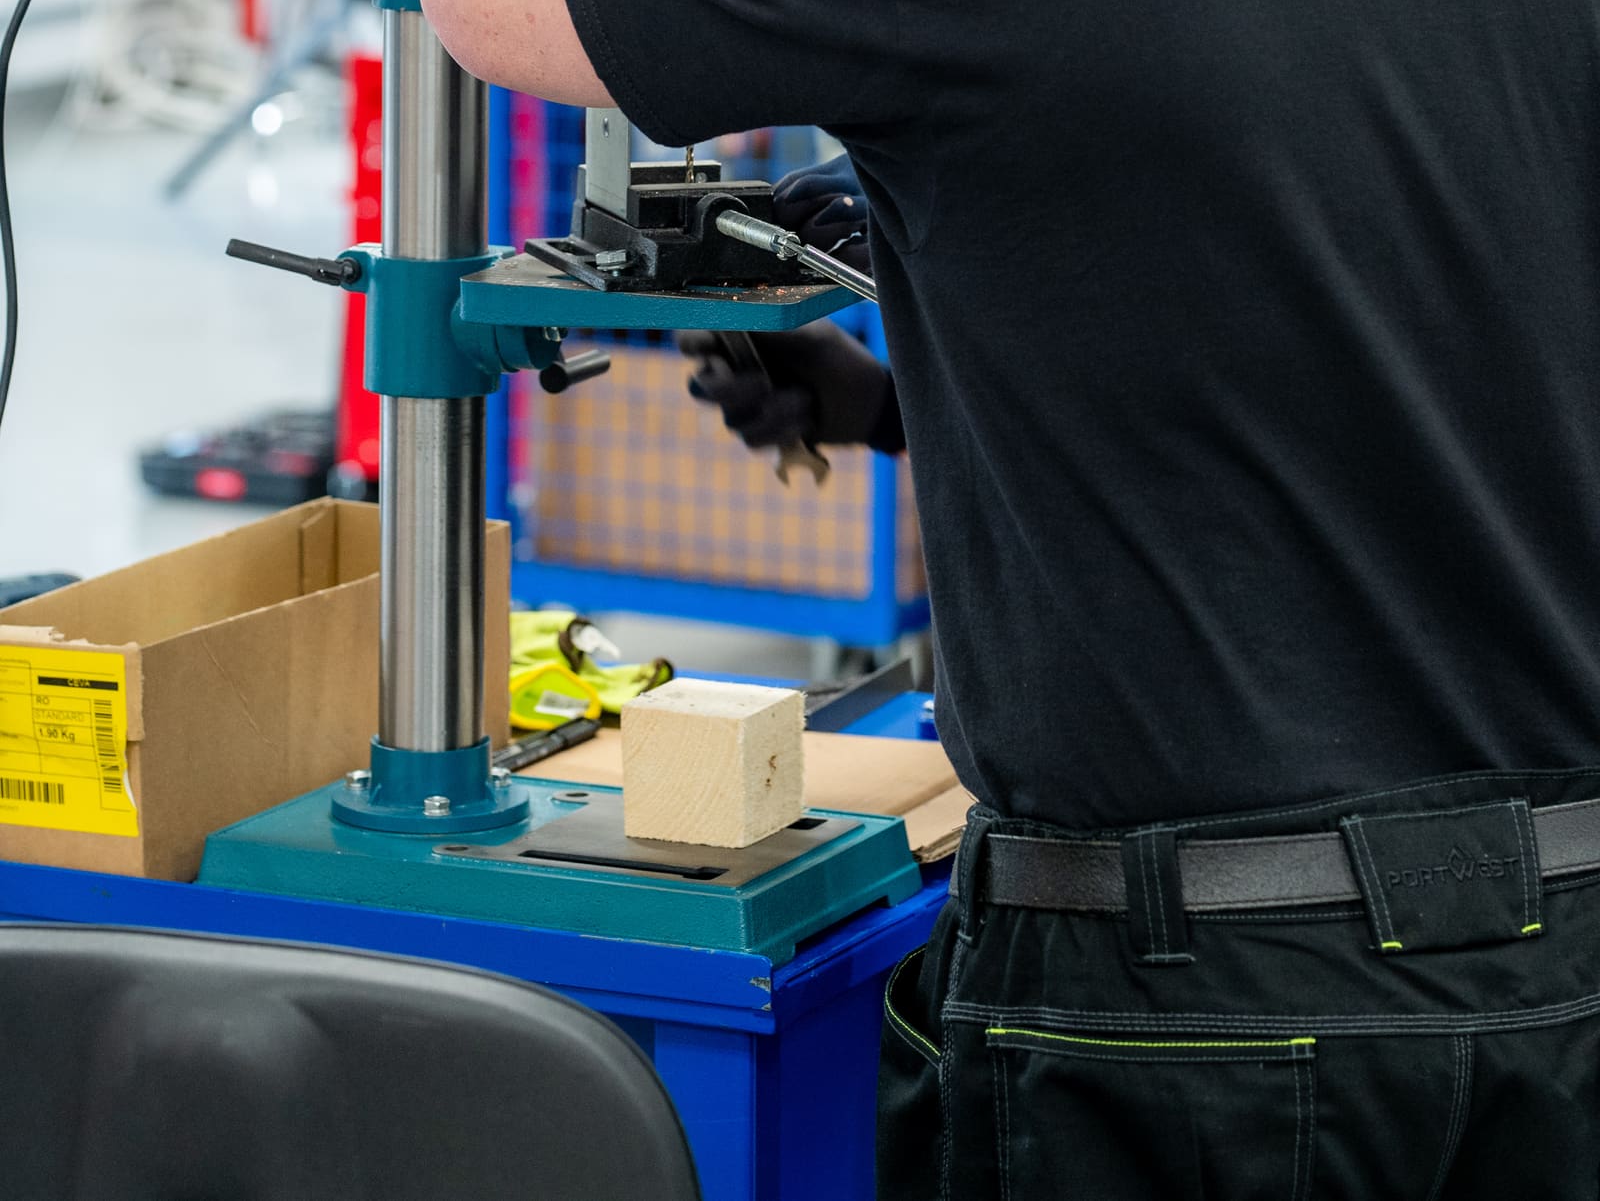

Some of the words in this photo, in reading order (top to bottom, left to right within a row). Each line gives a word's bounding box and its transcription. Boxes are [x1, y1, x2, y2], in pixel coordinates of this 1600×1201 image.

[36, 695, 49, 705] RO
[34, 711, 85, 722] STANDARD
[39, 728, 58, 738] 1.90
[61, 730, 75, 743] Kg
[1385, 851, 1520, 889] PORTWEST
